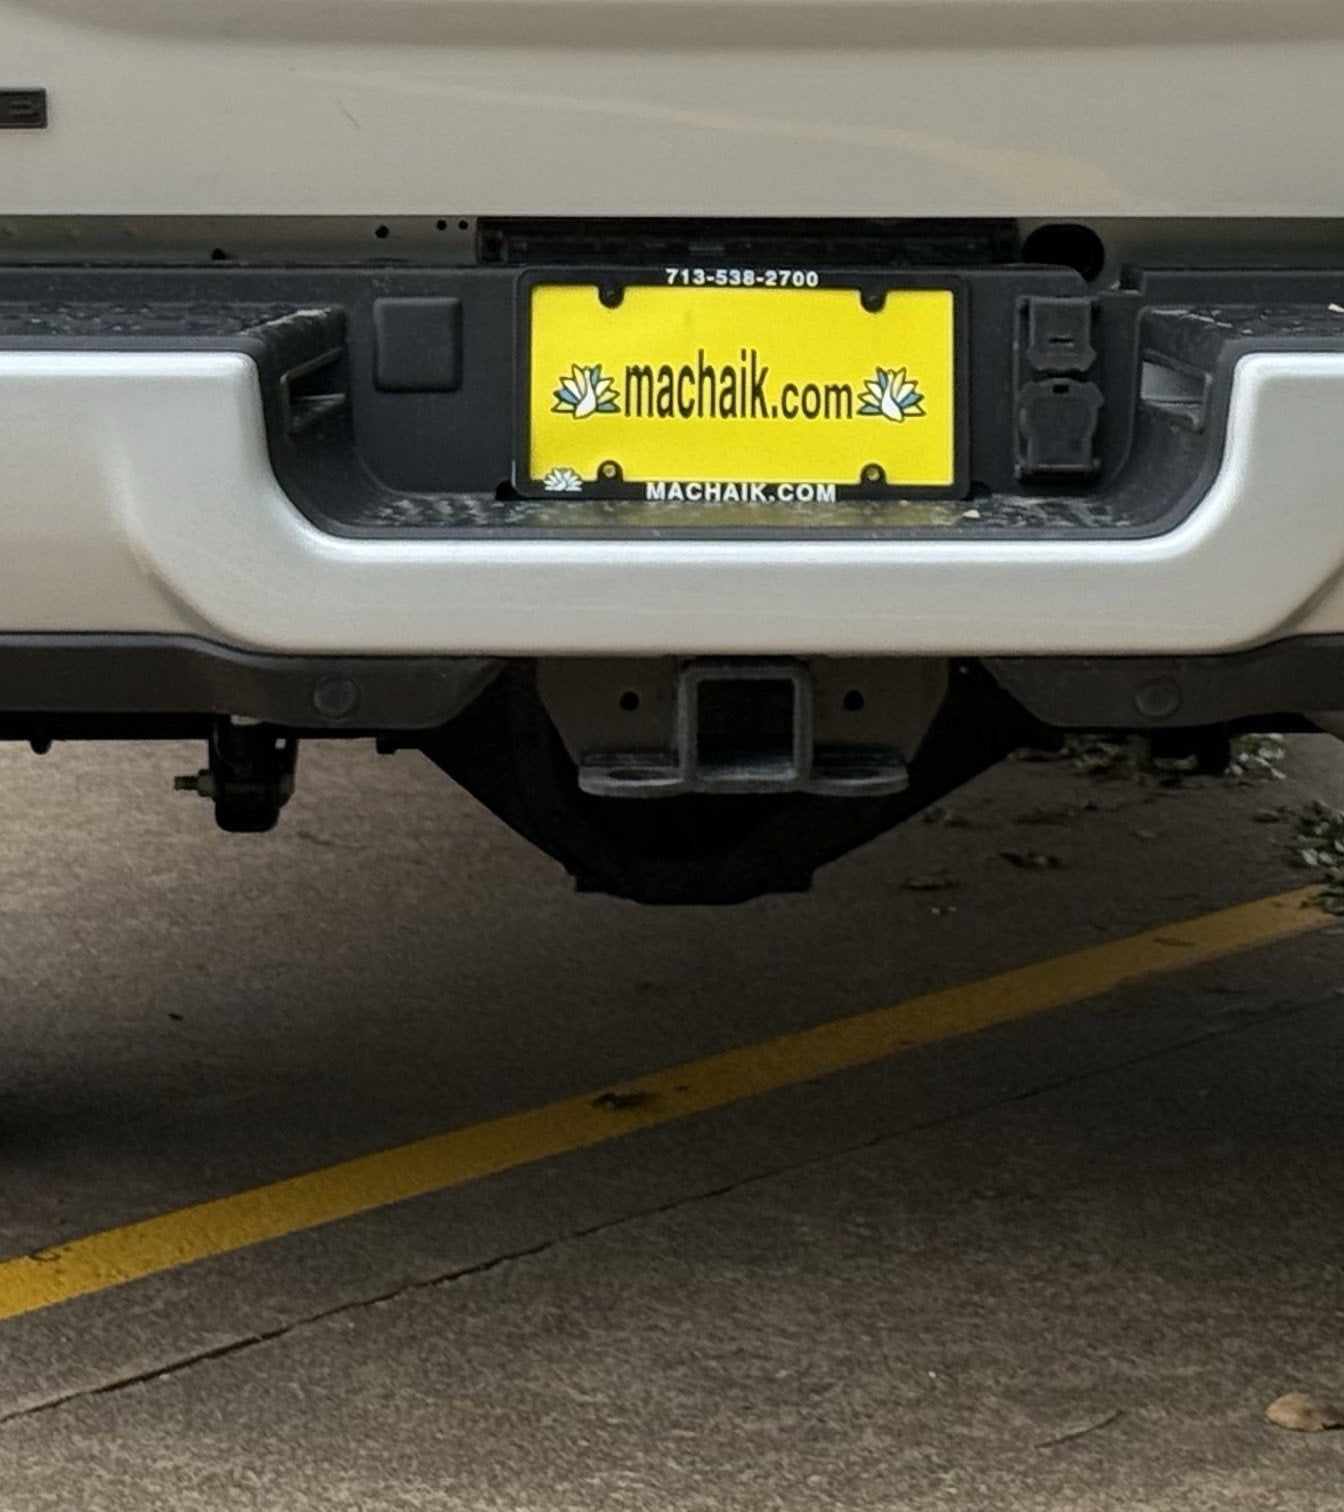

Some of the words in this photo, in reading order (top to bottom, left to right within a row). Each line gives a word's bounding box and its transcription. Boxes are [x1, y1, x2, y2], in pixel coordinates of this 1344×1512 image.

[665, 269, 819, 288] 713-538-2700
[624, 349, 853, 420] machaik.com
[645, 481, 837, 502] MACHAIK.COM
